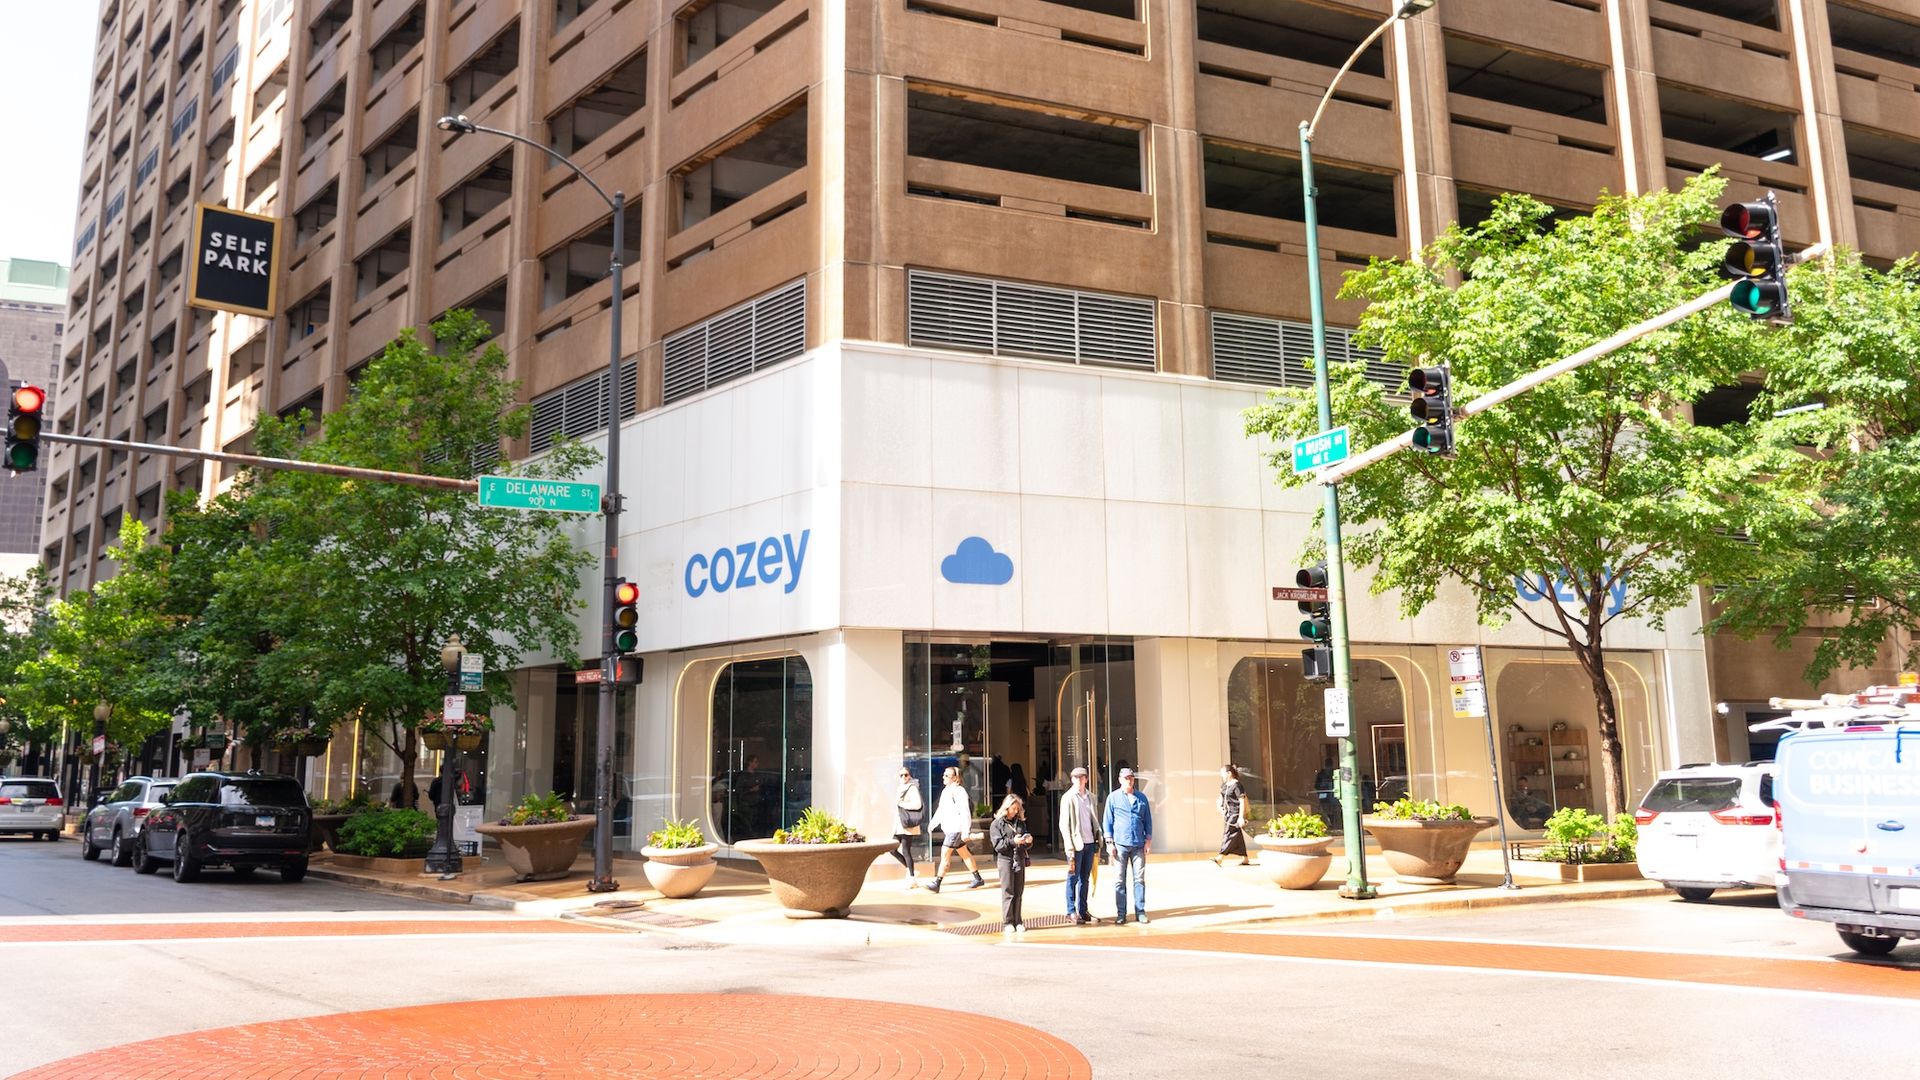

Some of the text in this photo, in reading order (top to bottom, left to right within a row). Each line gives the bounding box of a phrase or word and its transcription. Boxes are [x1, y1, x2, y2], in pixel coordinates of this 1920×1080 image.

[209, 231, 267, 256] SELF
[204, 249, 268, 276] PARK
[1305, 436, 1331, 456] RUSH
[490, 482, 496, 491] E
[506, 481, 571, 498] DELAWARE
[550, 498, 556, 506] N
[684, 528, 811, 598] cozey
[1276, 591, 1289, 599] JACK
[1513, 564, 1631, 616] ozy
